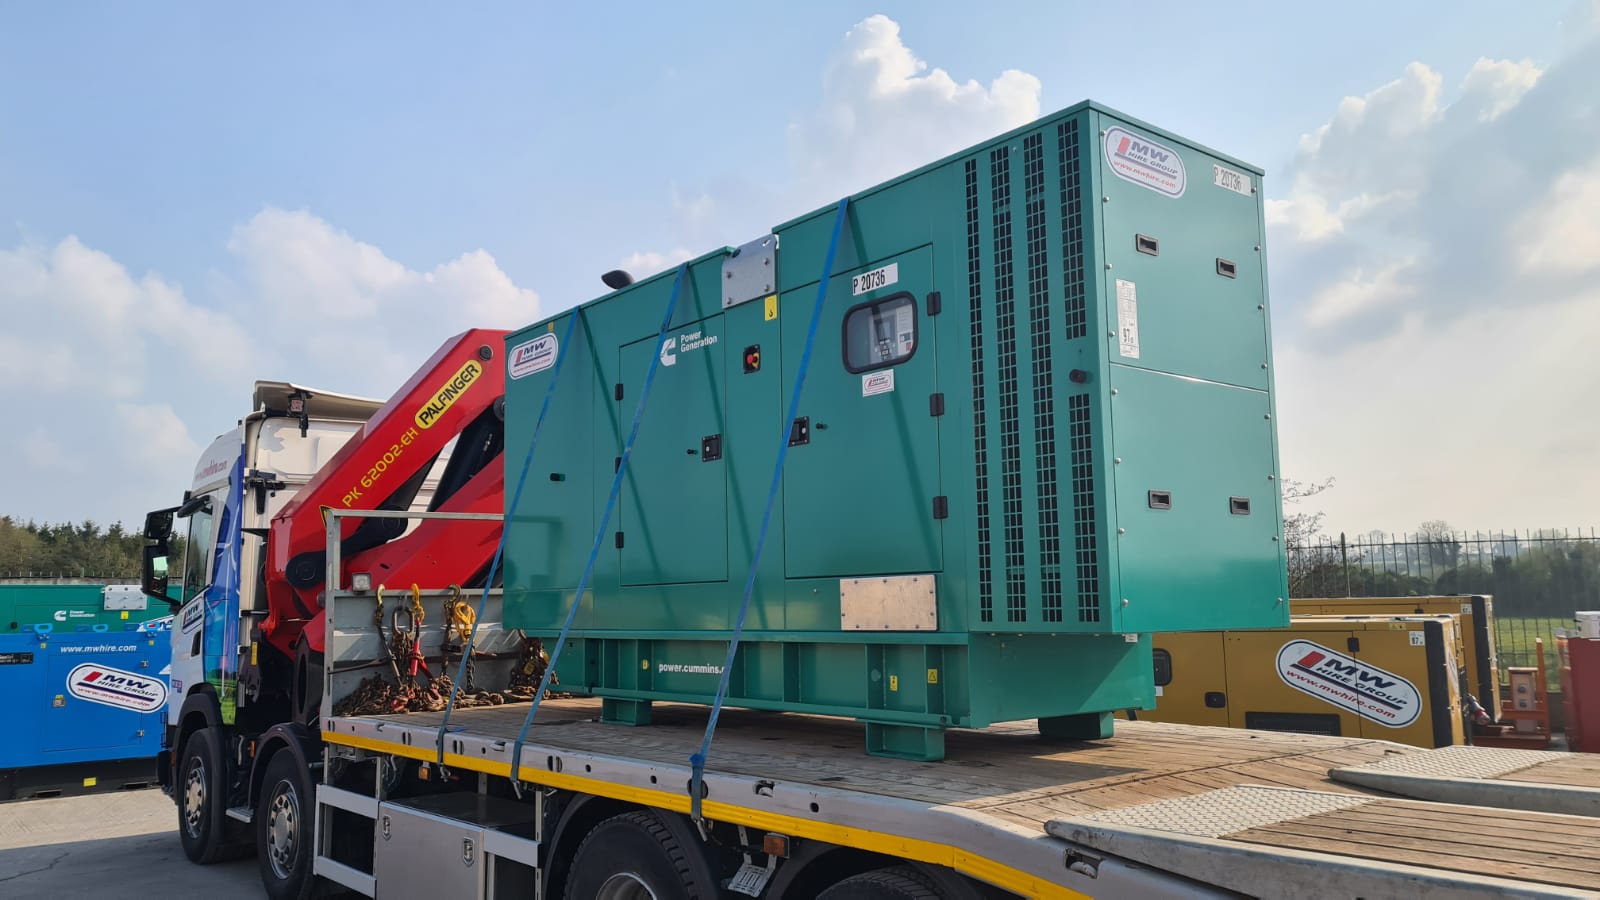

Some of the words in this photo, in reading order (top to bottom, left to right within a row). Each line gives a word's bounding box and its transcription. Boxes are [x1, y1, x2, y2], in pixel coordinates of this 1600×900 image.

[1128, 151, 1148, 164] HIRE
[1150, 160, 1178, 175] GROUP
[1131, 141, 1169, 162] MW
[1213, 166, 1219, 183] P
[1220, 169, 1242, 191] 20736
[853, 278, 859, 294] P
[861, 269, 886, 291] 20736
[523, 340, 547, 355] MW
[680, 330, 702, 343] Power
[680, 335, 718, 352] Generation
[418, 363, 479, 426] PALFINGER
[342, 486, 364, 508] PK
[360, 427, 419, 488] 62002-EH
[60, 644, 137, 653] www.mwhire.com
[102, 674, 152, 689] MW
[1324, 658, 1397, 689] MW
[1286, 670, 1396, 719] www.mwhire.com
[1316, 667, 1353, 683] HIRE
[1354, 682, 1408, 705] GROUP
